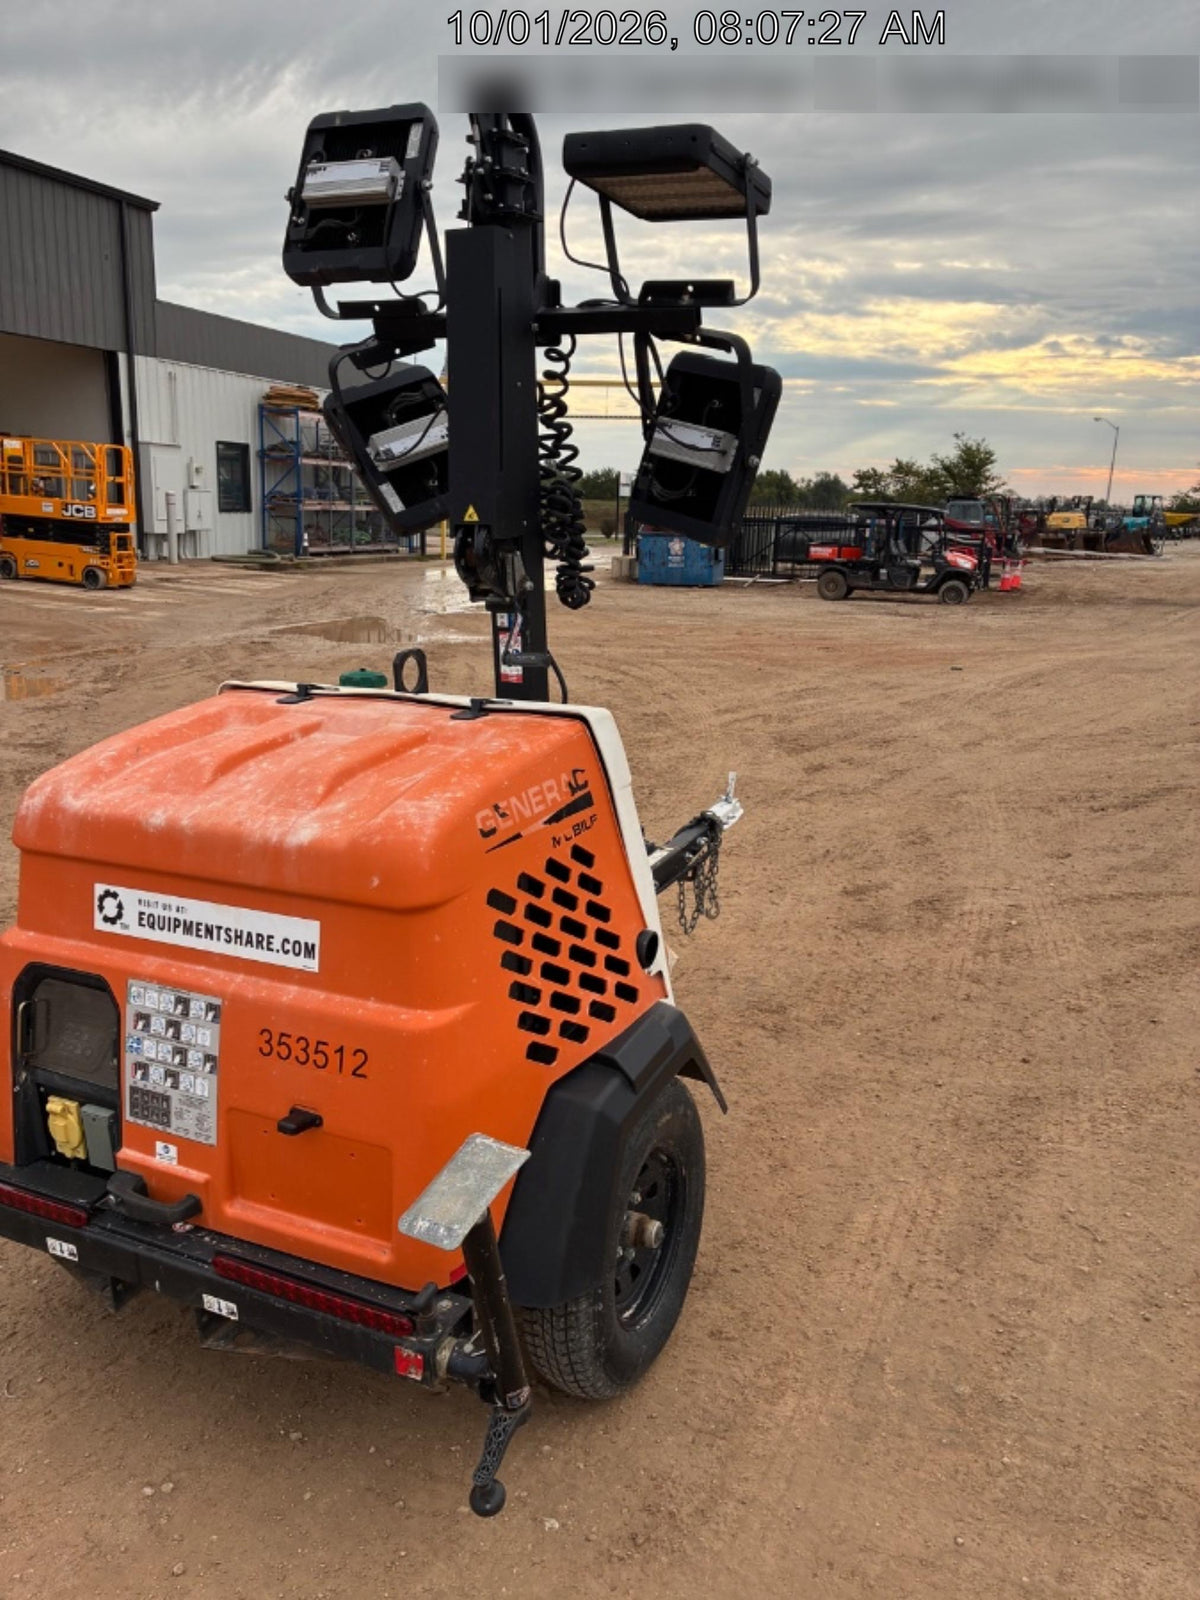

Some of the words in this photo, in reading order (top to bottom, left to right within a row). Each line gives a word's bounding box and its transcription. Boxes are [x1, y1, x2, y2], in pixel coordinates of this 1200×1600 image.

[62, 504, 97, 518] JCB
[138, 911, 316, 961] EQUIPMENTSHARE.COM
[259, 1028, 368, 1079] 353512
